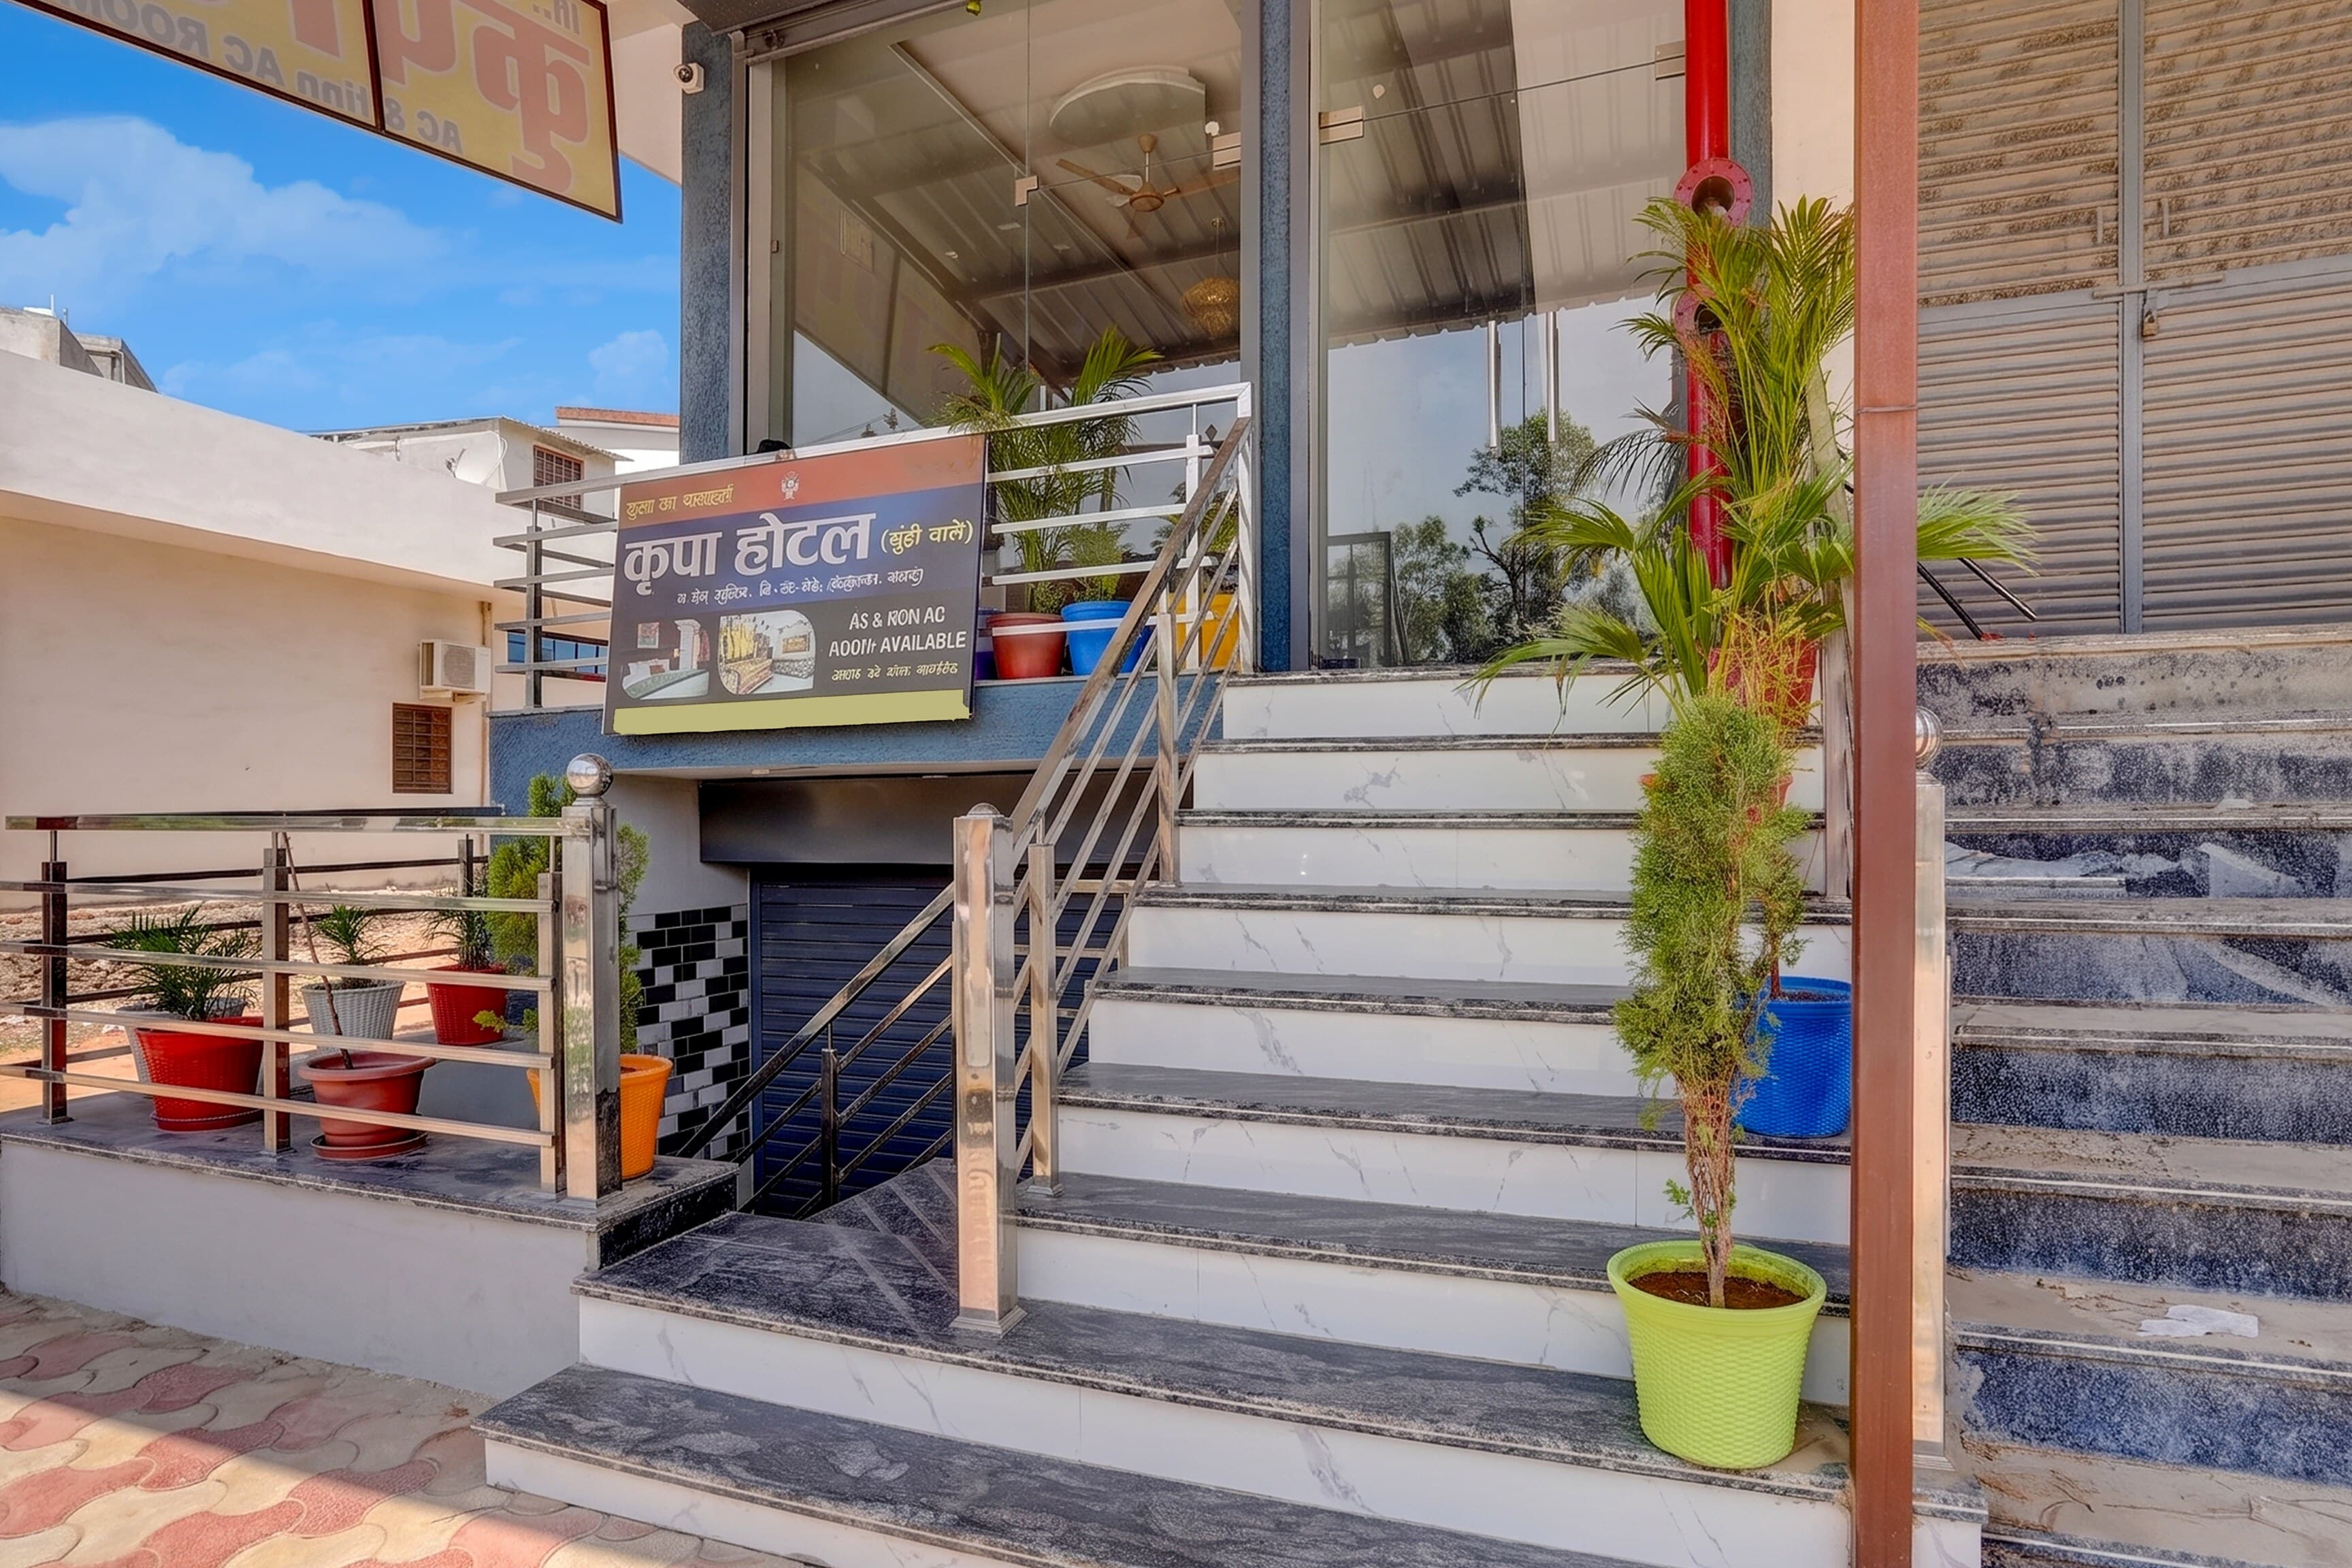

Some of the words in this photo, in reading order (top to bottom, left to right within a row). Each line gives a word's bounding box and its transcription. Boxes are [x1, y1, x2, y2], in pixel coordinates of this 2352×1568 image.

[623, 532, 723, 595] कृपा
[734, 512, 877, 576] होटल
[872, 612, 883, 627] &
[923, 606, 945, 624] AC
[880, 631, 967, 653] AVAILABLE
